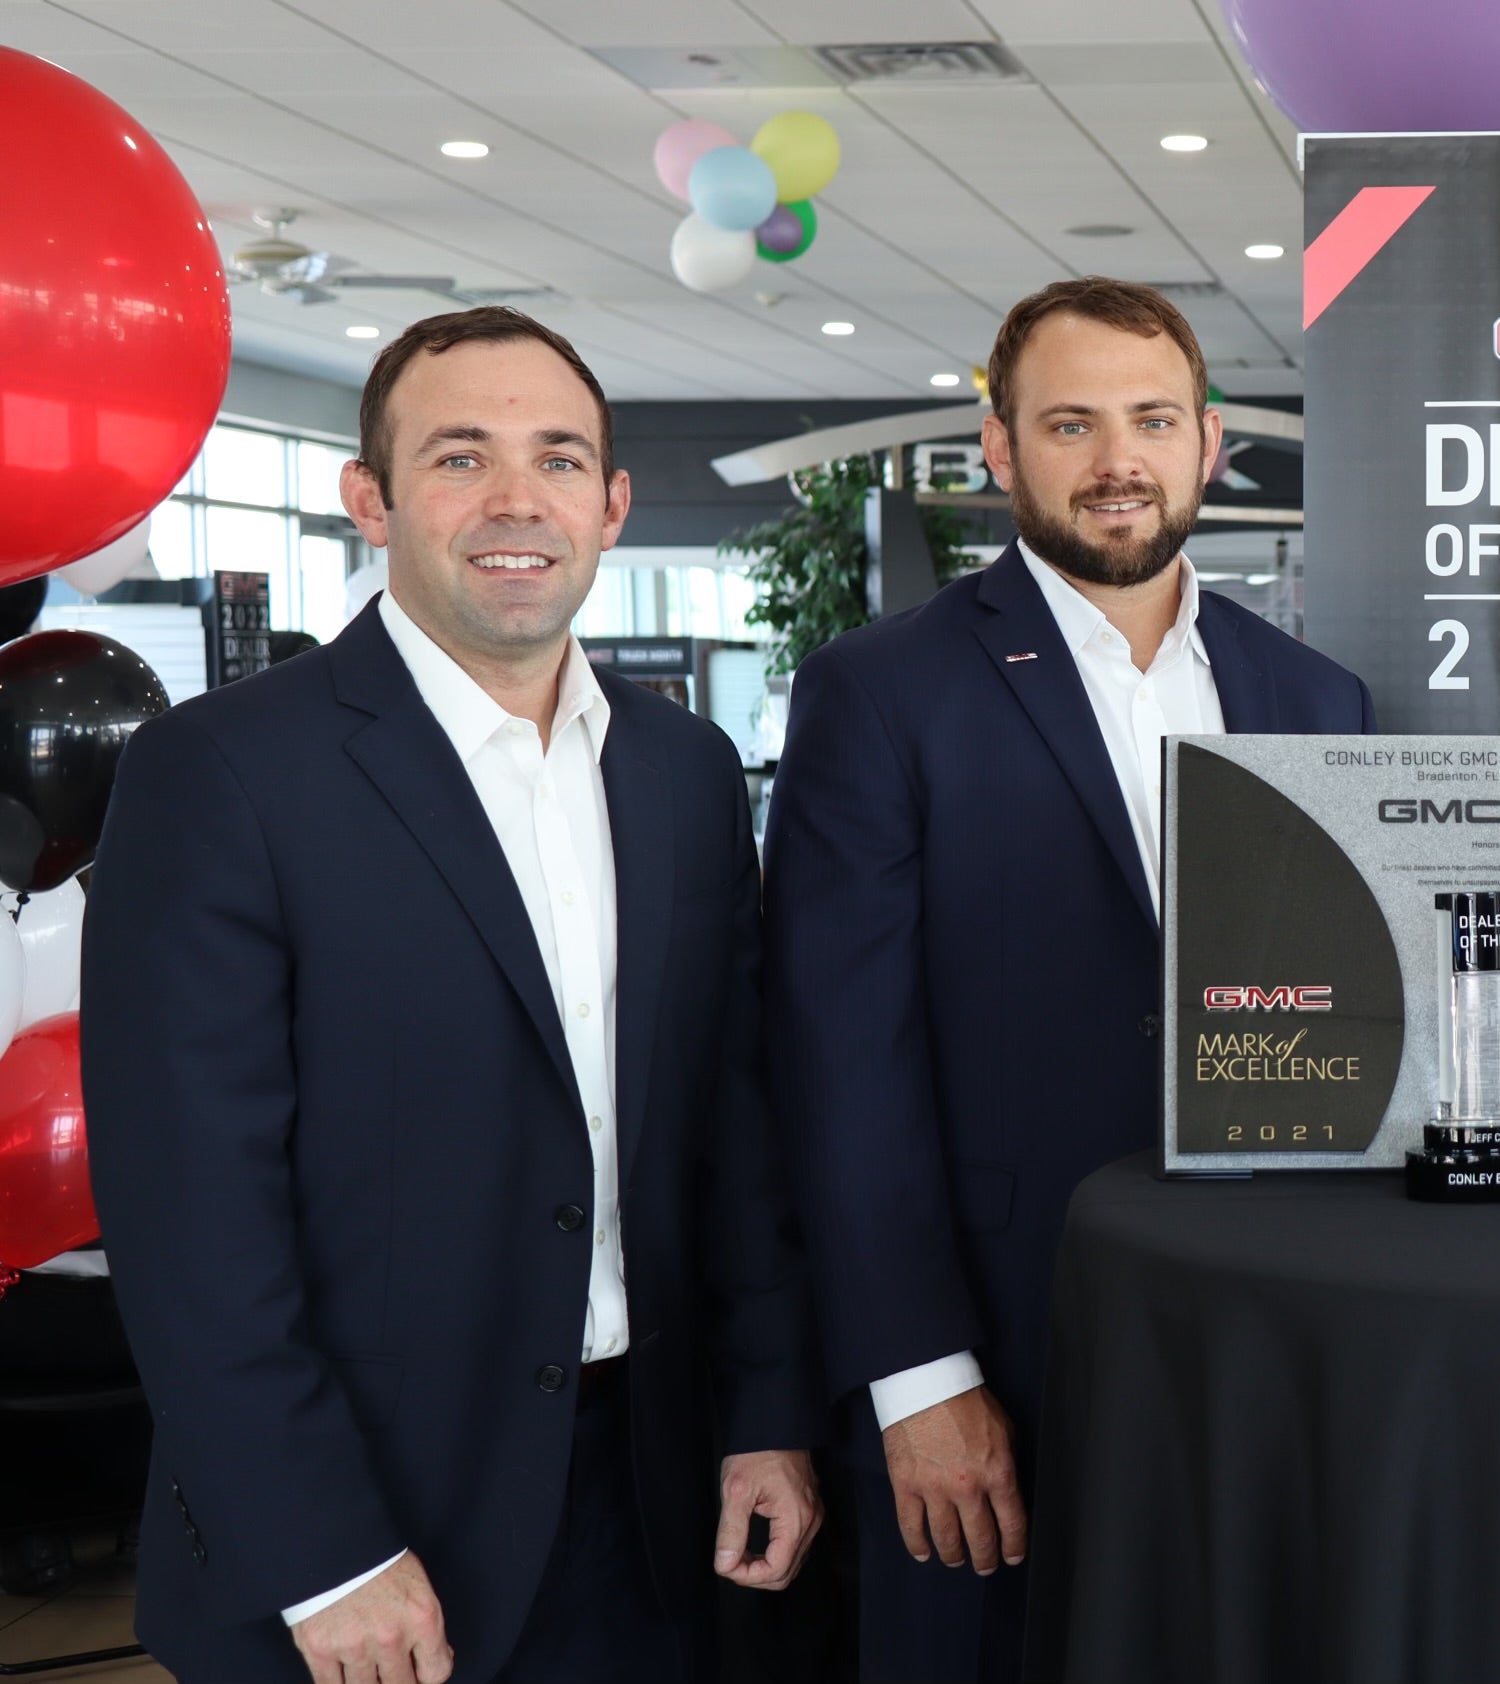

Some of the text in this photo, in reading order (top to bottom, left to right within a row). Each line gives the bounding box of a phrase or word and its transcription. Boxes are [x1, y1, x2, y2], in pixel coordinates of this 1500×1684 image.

[222, 603, 269, 630] 2022
[1325, 751, 1498, 766] CONLEY BUICK GMC
[1485, 772, 1500, 781] FL
[1471, 841, 1500, 849] Honors
[1460, 935, 1478, 949] OF
[1204, 986, 1332, 1012] GMC
[1197, 1027, 1309, 1065] MARK of
[1196, 1057, 1360, 1081] EXCELLENCE
[1227, 1125, 1334, 1141] 2021
[1470, 1133, 1493, 1144] JEFF
[1448, 1172, 1494, 1185] CONLEY
